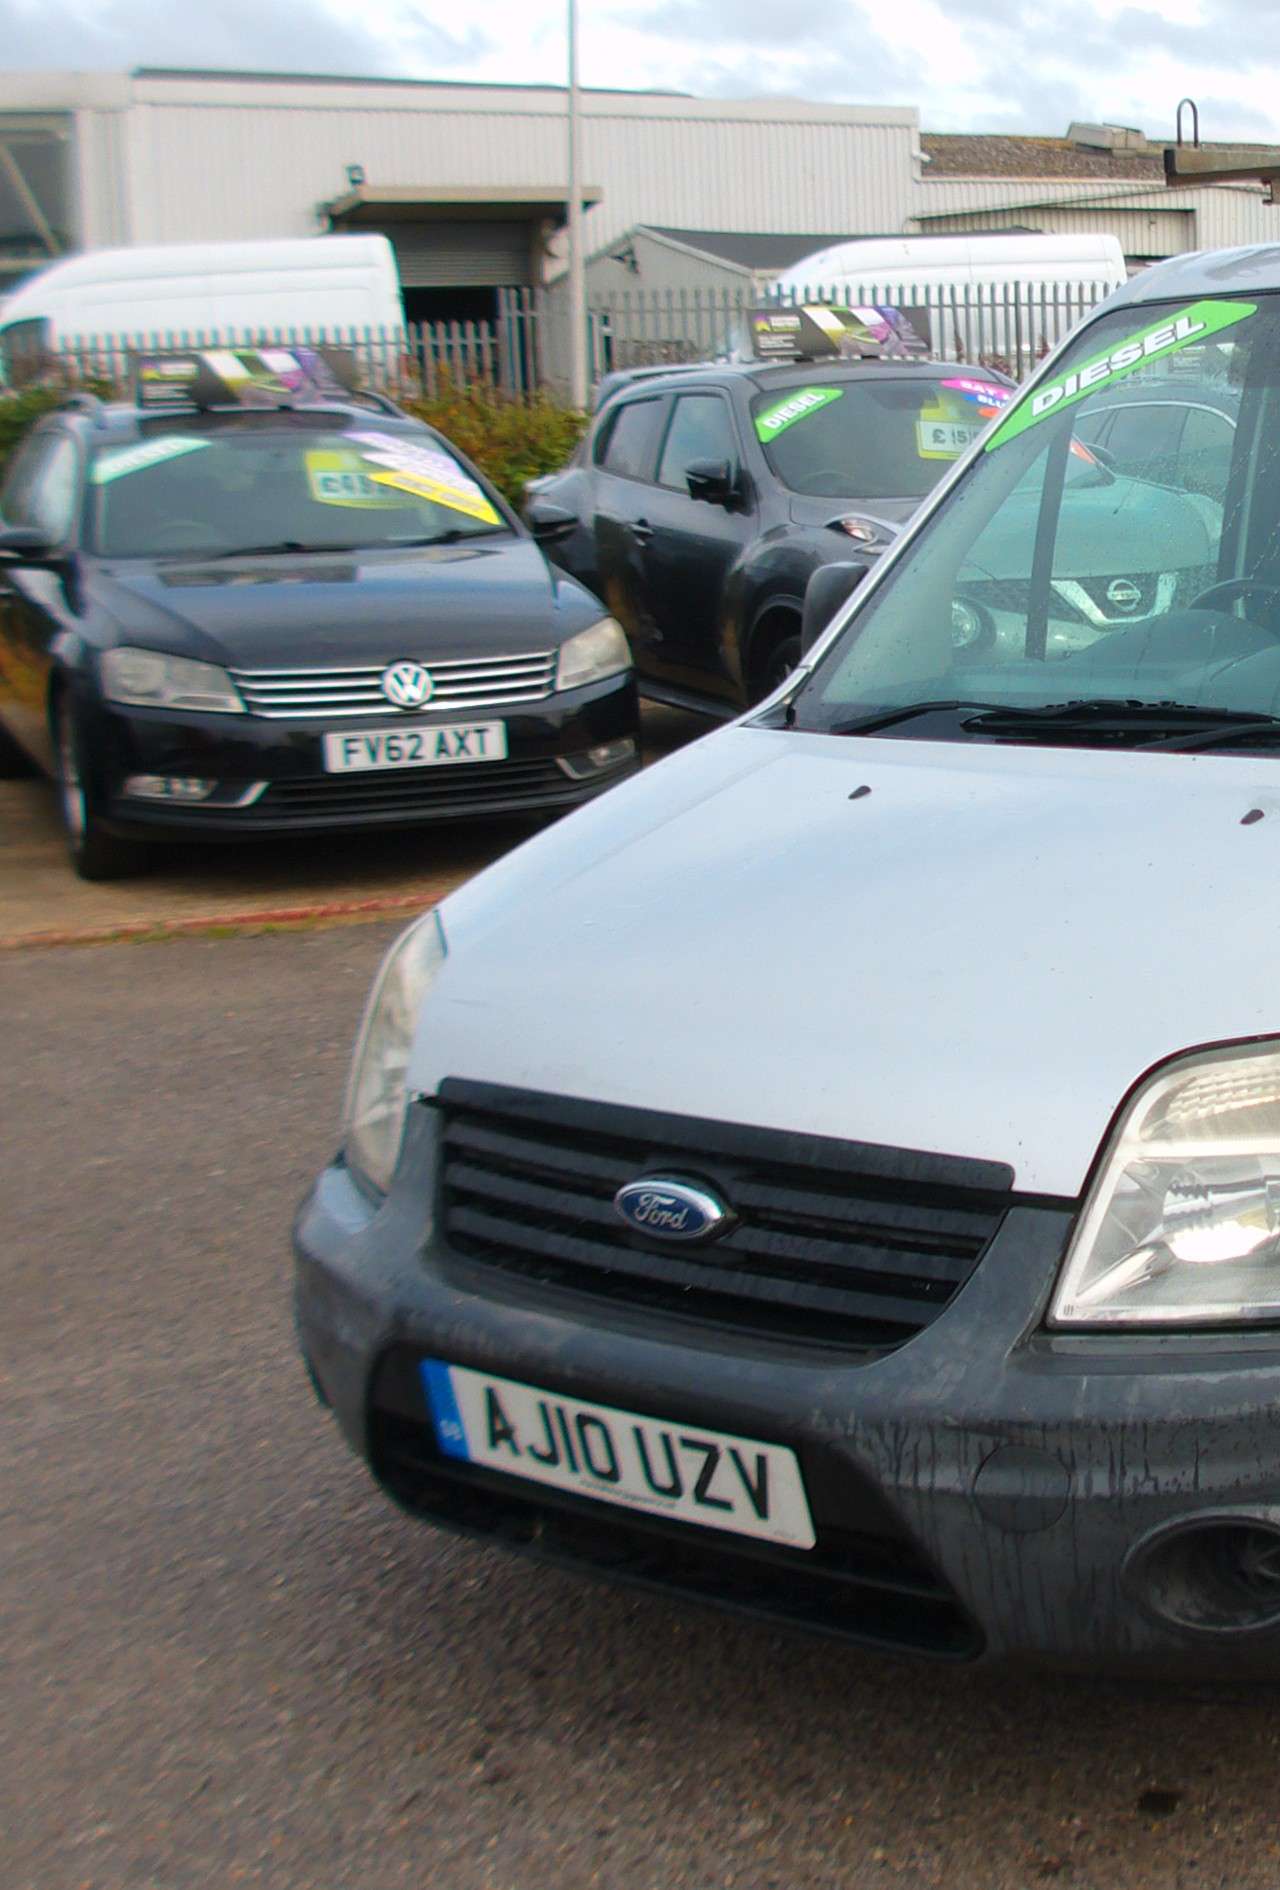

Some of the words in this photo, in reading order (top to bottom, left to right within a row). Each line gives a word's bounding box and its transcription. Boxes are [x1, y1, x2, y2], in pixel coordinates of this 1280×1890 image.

[1032, 316, 1207, 417] DIESEL
[343, 733, 424, 766] FV62
[435, 728, 489, 759] AXT
[634, 1193, 689, 1230] Ford
[485, 1385, 621, 1483] AJ10
[632, 1425, 771, 1521] UZV
